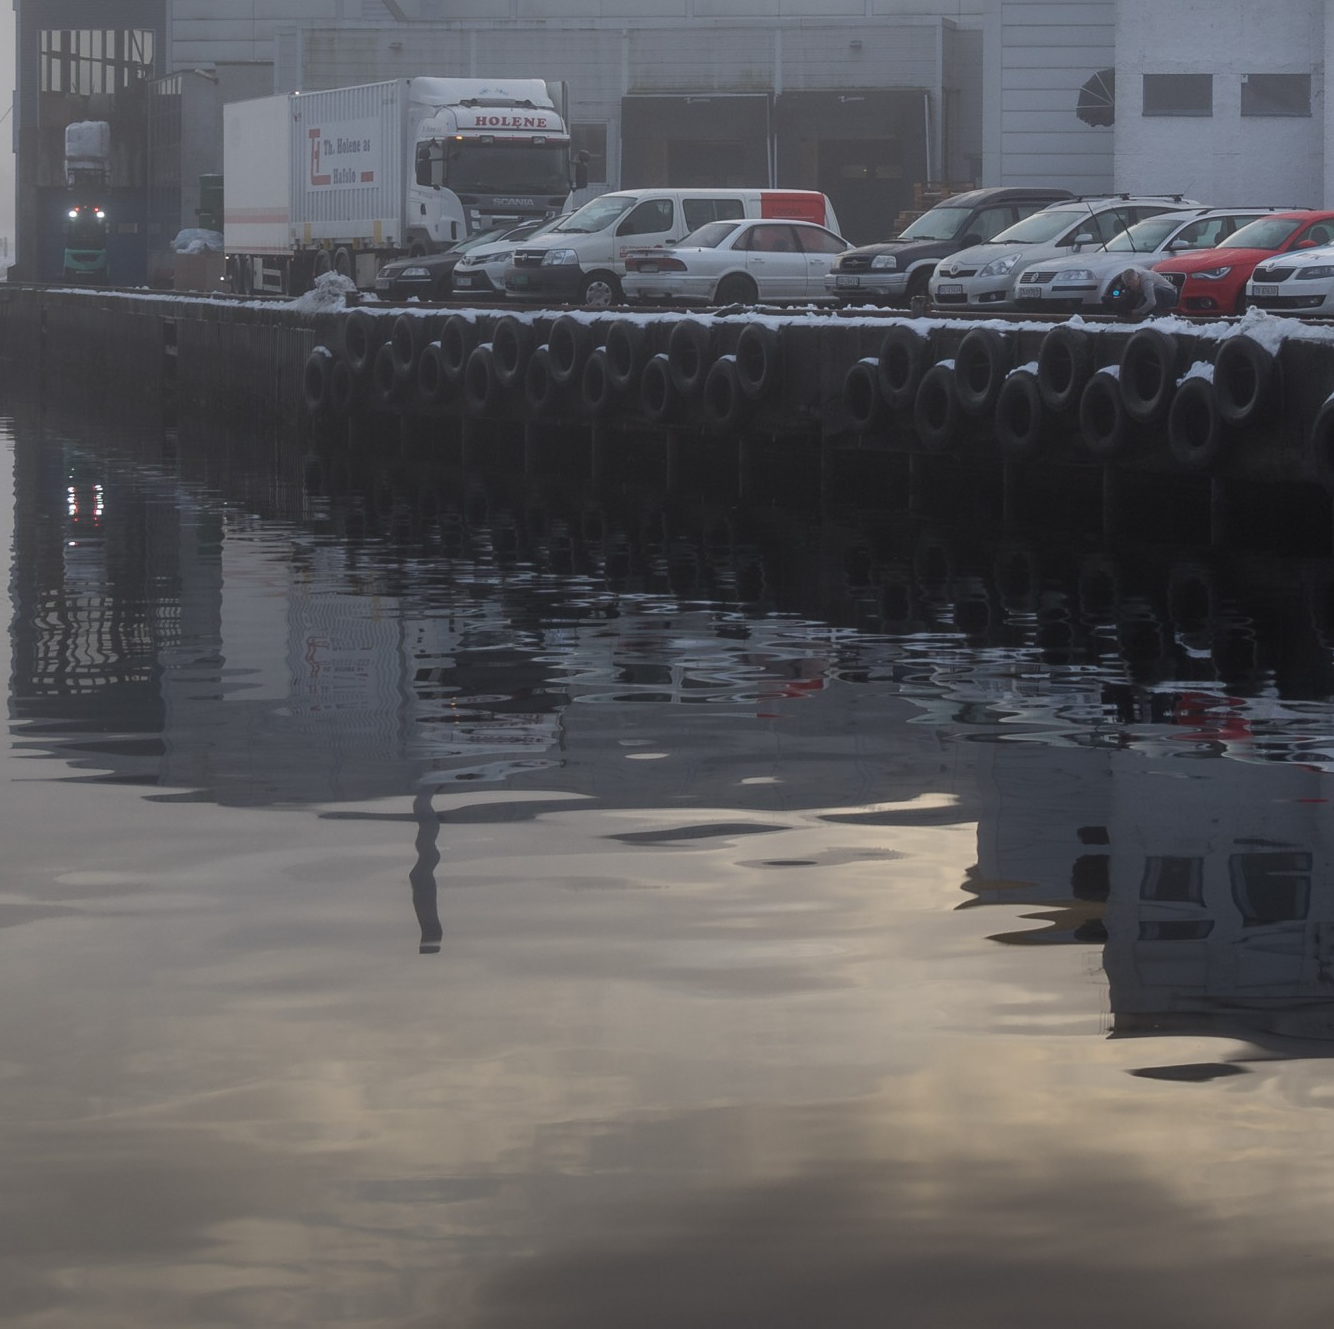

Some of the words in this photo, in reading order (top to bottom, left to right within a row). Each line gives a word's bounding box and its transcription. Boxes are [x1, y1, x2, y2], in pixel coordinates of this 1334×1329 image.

[475, 116, 547, 128] HOLENE
[323, 139, 335, 156] Th.
[337, 138, 361, 154] Holene
[363, 139, 371, 152] as
[492, 198, 535, 206] SCANIA
